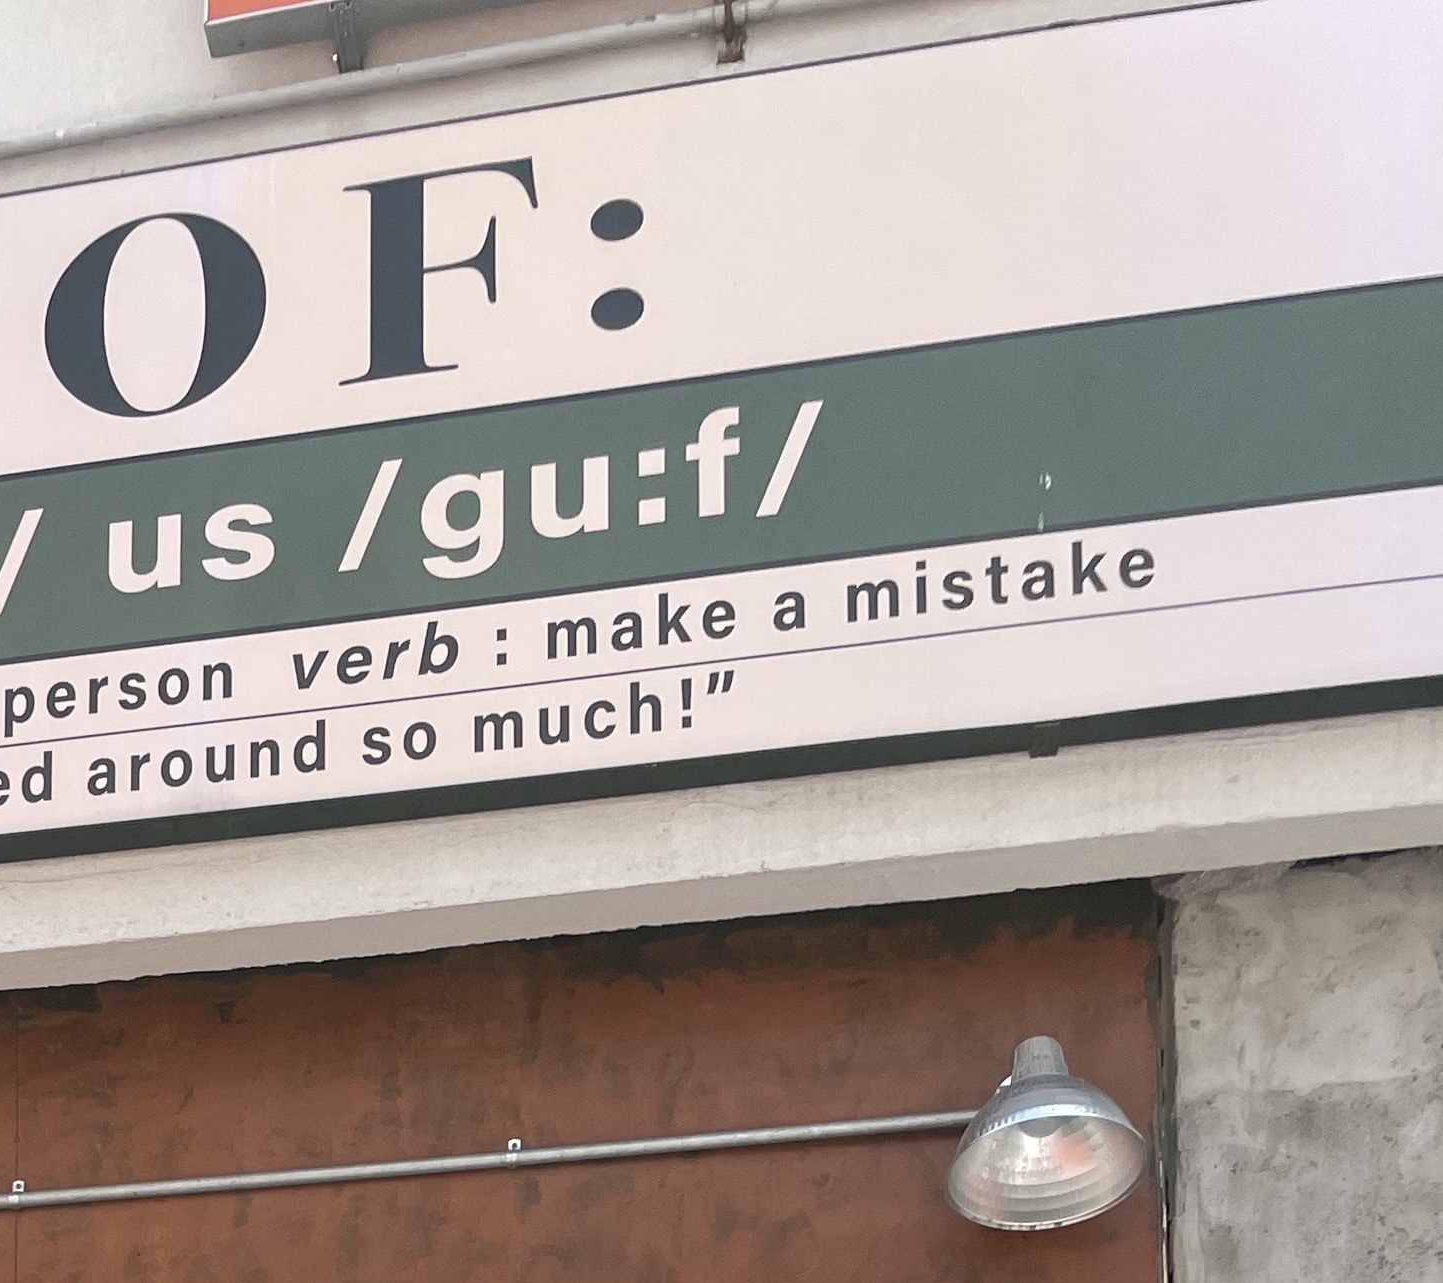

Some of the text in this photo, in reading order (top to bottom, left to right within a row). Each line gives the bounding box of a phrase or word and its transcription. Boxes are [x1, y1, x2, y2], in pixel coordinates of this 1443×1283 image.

[108, 503, 275, 593] us
[339, 400, 824, 579] /gu:f/
[4, 662, 232, 739] person
[292, 620, 459, 690] verb
[547, 593, 736, 661] make
[773, 591, 805, 632] a
[847, 541, 1154, 624] mistake
[87, 720, 326, 796] around
[362, 722, 437, 765] so
